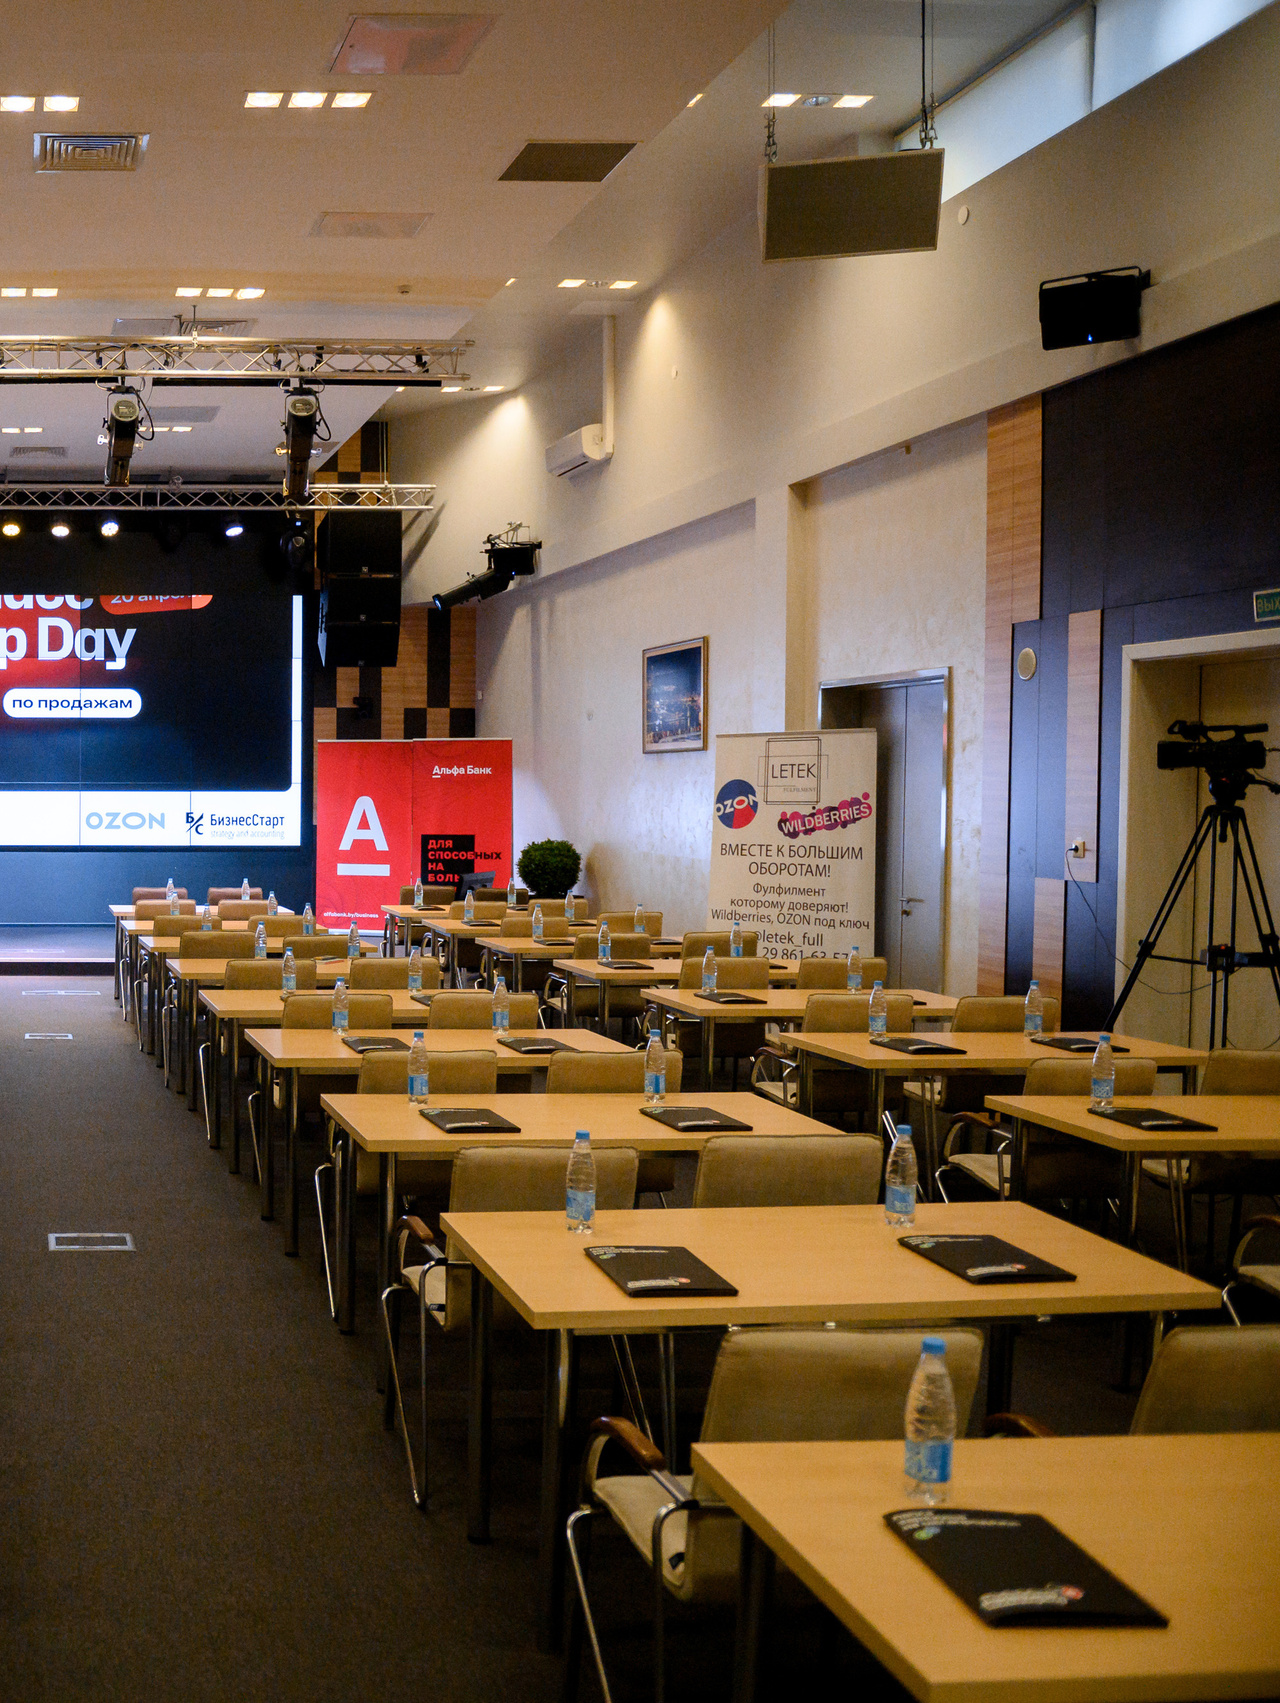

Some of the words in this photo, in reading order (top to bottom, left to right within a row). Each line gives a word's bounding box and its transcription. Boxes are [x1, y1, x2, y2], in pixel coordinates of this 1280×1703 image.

[37, 616, 137, 670] Day
[13, 699, 33, 708] по
[38, 699, 132, 711] продажам
[432, 765, 465, 777] Альфа
[467, 765, 492, 775] Банк
[772, 763, 816, 779] LETEK
[716, 793, 757, 816] OZON
[85, 812, 165, 830] OZON
[210, 813, 284, 829] БизнесСтарт
[781, 804, 870, 834] WILDBERRIES
[428, 840, 453, 850] ДЛЯ
[720, 843, 773, 857] ВМЕСТЕ
[776, 844, 785, 857] К
[789, 845, 863, 860] БОЛЬШИМ
[428, 851, 502, 860] СПОСОБНЫХ
[428, 863, 444, 871] НА
[749, 862, 831, 877] ОБОРОТАМ!
[753, 882, 826, 897] Фулфилмент
[730, 898, 785, 911] которому
[787, 901, 849, 914] доверяют!
[711, 909, 774, 924] Wildberries,
[777, 912, 811, 926] OZON
[815, 917, 836, 929] под
[840, 918, 870, 930] ключ
[762, 947, 778, 960] 29
[781, 948, 848, 960] 861-63
